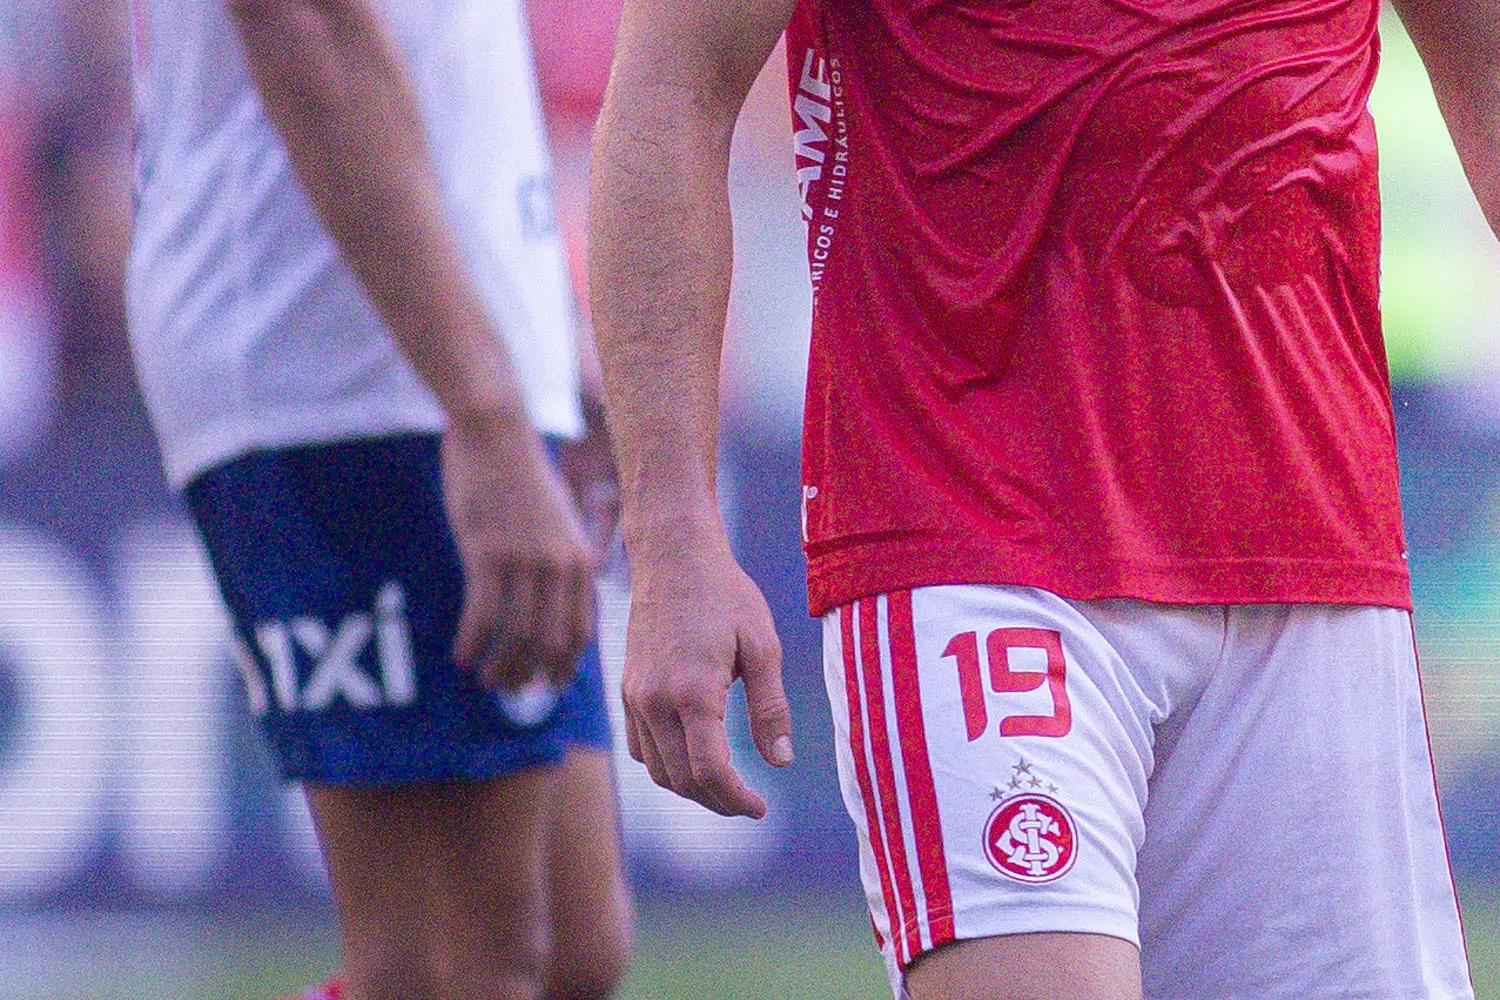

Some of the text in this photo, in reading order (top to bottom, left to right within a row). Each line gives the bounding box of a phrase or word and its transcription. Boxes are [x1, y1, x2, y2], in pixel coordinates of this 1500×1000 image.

[811, 223, 835, 306] RICOS
[823, 206, 839, 219] E
[940, 626, 1073, 742] 19
